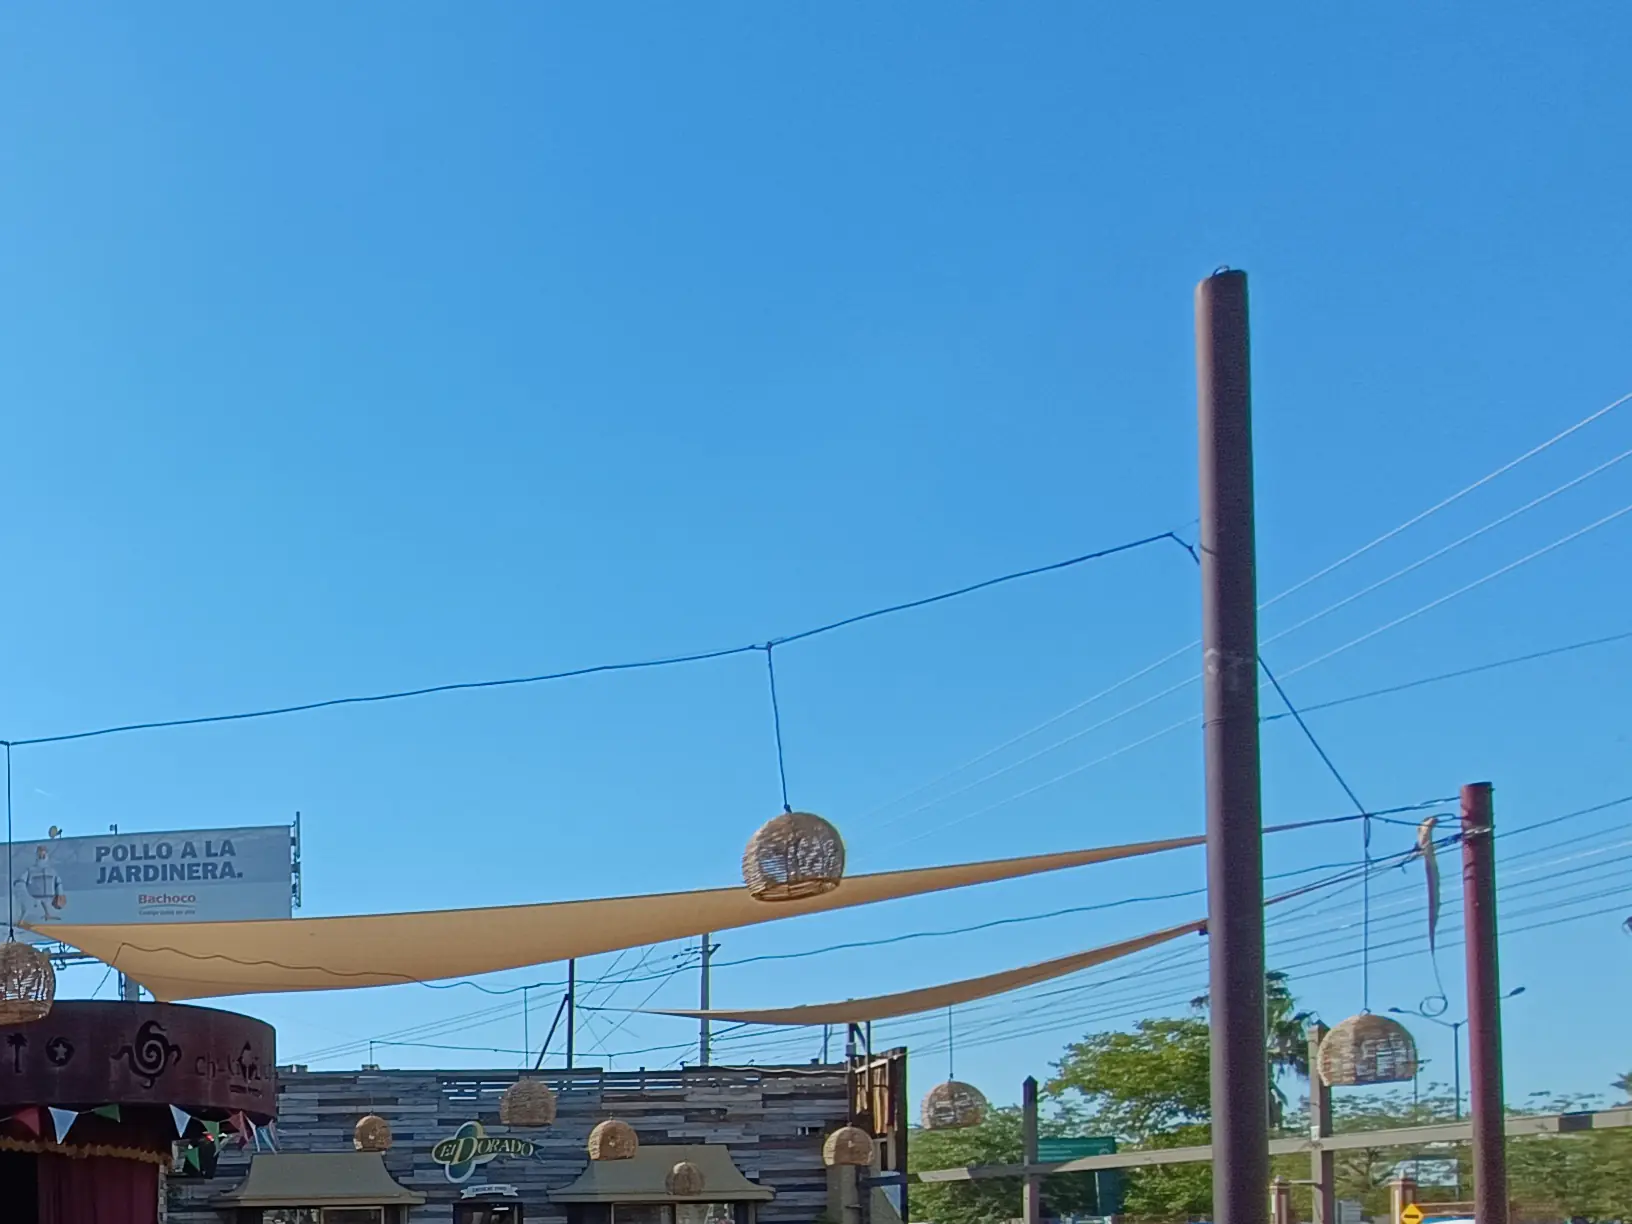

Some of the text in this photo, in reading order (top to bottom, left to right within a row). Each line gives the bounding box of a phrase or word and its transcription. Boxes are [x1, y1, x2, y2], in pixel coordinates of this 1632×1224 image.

[95, 840, 237, 862] POLLO A LA
[97, 862, 243, 884] JARDINERA.
[138, 893, 196, 903] Bachoco
[450, 1137, 534, 1165] DORADO
